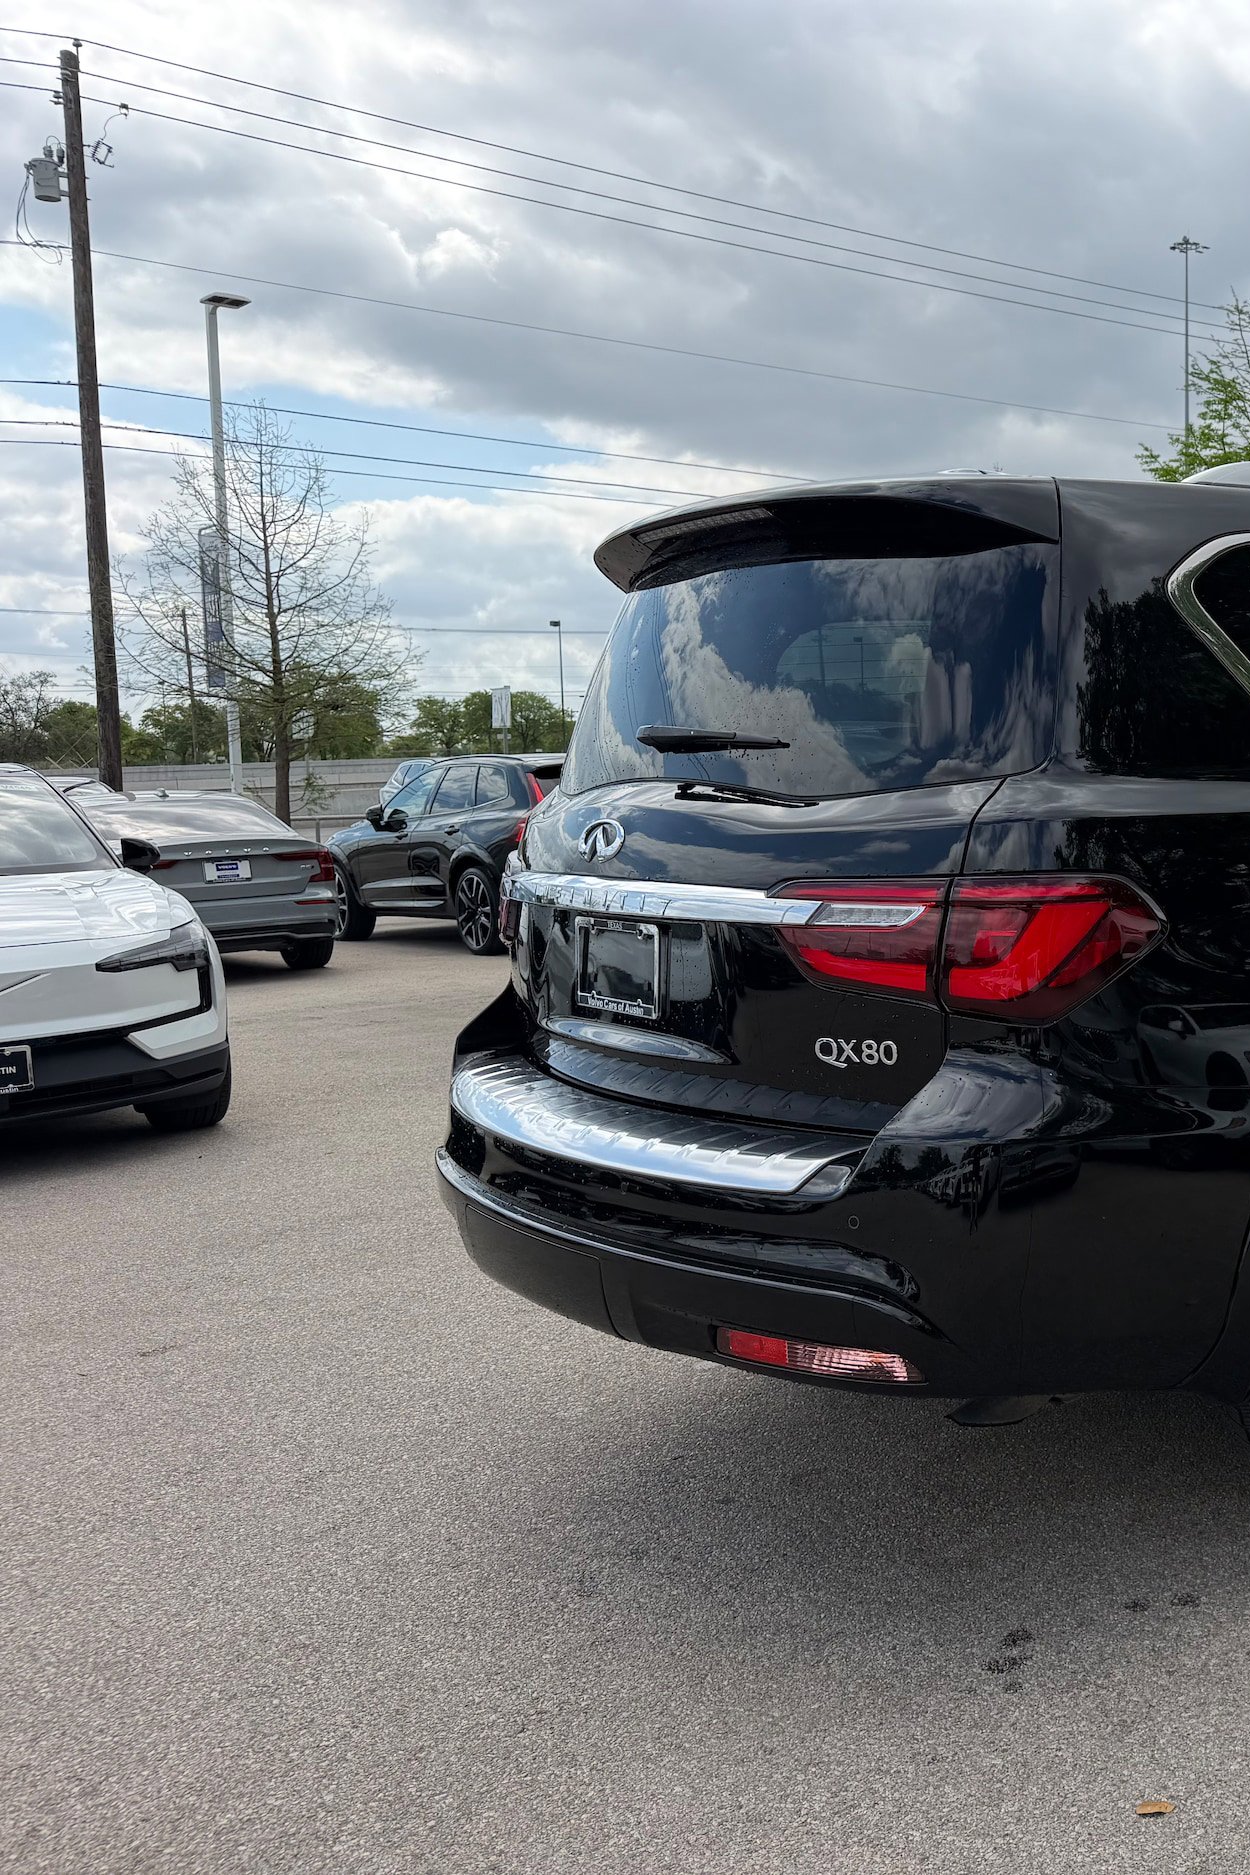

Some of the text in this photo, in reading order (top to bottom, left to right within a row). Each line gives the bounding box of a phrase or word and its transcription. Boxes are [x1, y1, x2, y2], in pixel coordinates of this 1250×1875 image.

[183, 847, 269, 856] VOLVO
[607, 921, 623, 929] TEXAS
[588, 996, 644, 1016] Volvo Cars of Austin
[815, 1038, 898, 1069] QX80
[0, 1066, 16, 1074] TIN
